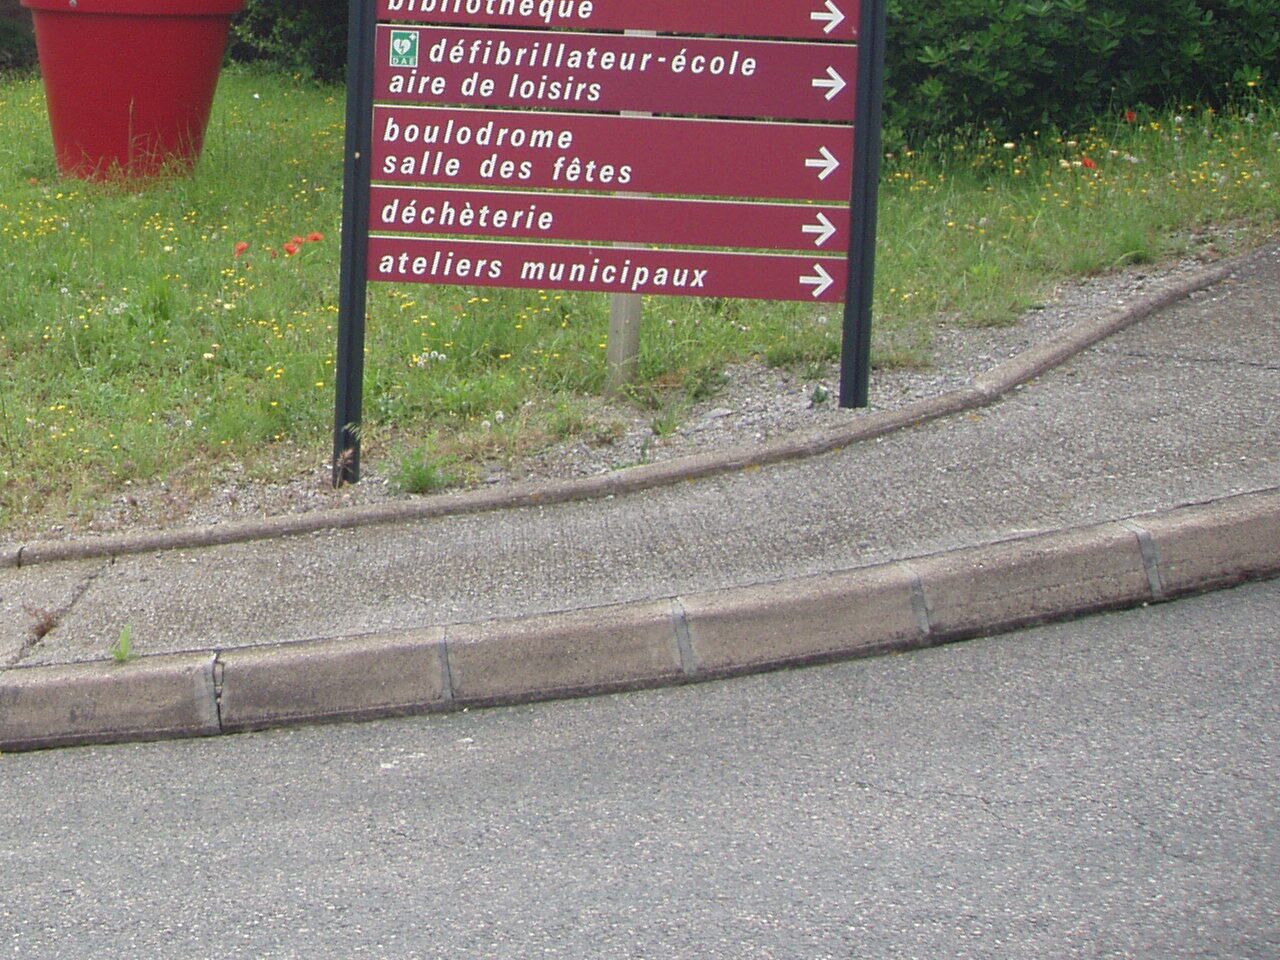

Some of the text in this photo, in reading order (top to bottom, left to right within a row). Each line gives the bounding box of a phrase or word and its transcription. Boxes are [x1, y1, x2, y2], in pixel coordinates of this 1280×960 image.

[429, 38, 757, 76] défibrillateur-école
[389, 71, 602, 101] aire de loisirs
[384, 117, 573, 149] boulodrome
[383, 151, 632, 184] salle des fêtes
[381, 199, 554, 230] déchèterie
[379, 251, 708, 291] ateliers municipaux
